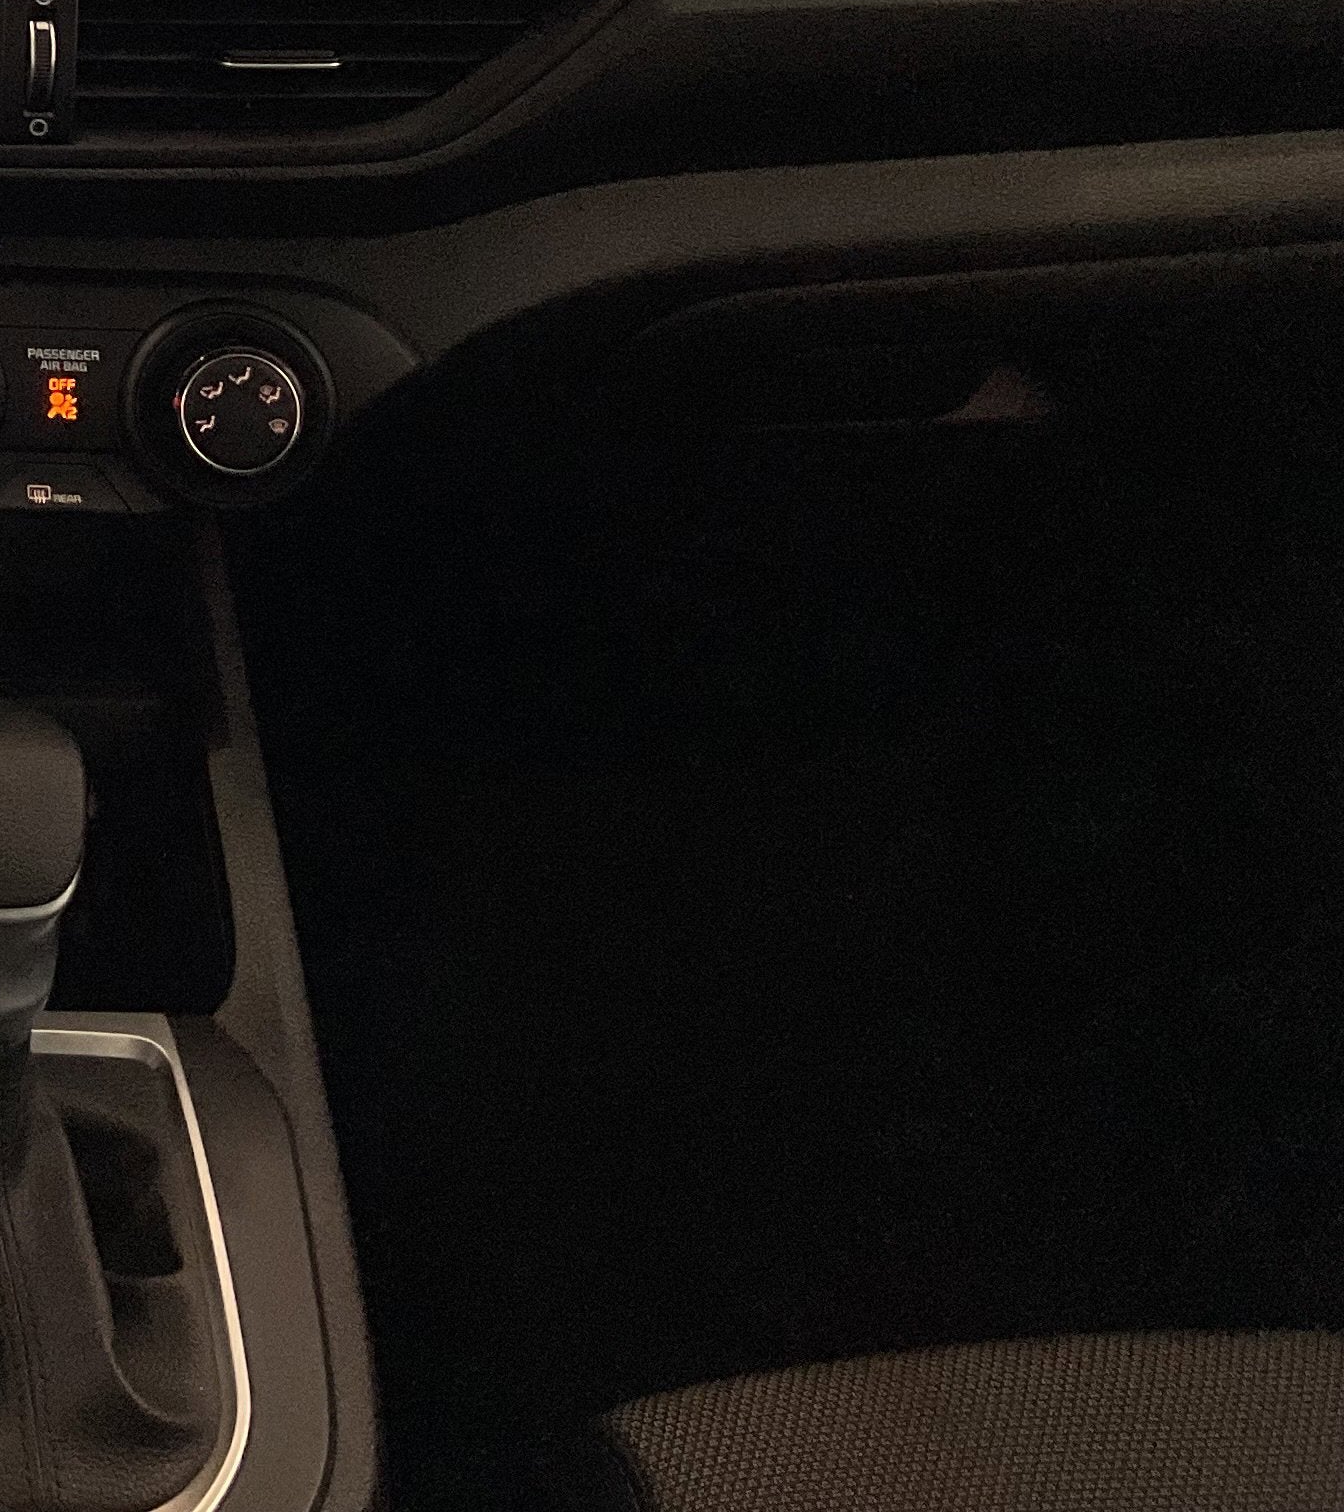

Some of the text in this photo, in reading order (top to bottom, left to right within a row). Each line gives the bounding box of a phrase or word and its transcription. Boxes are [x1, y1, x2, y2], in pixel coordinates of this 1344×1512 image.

[27, 347, 100, 362] PASSENGER
[40, 360, 88, 373] AIR BAG
[48, 377, 76, 391] OFF
[52, 493, 82, 504] REAR
